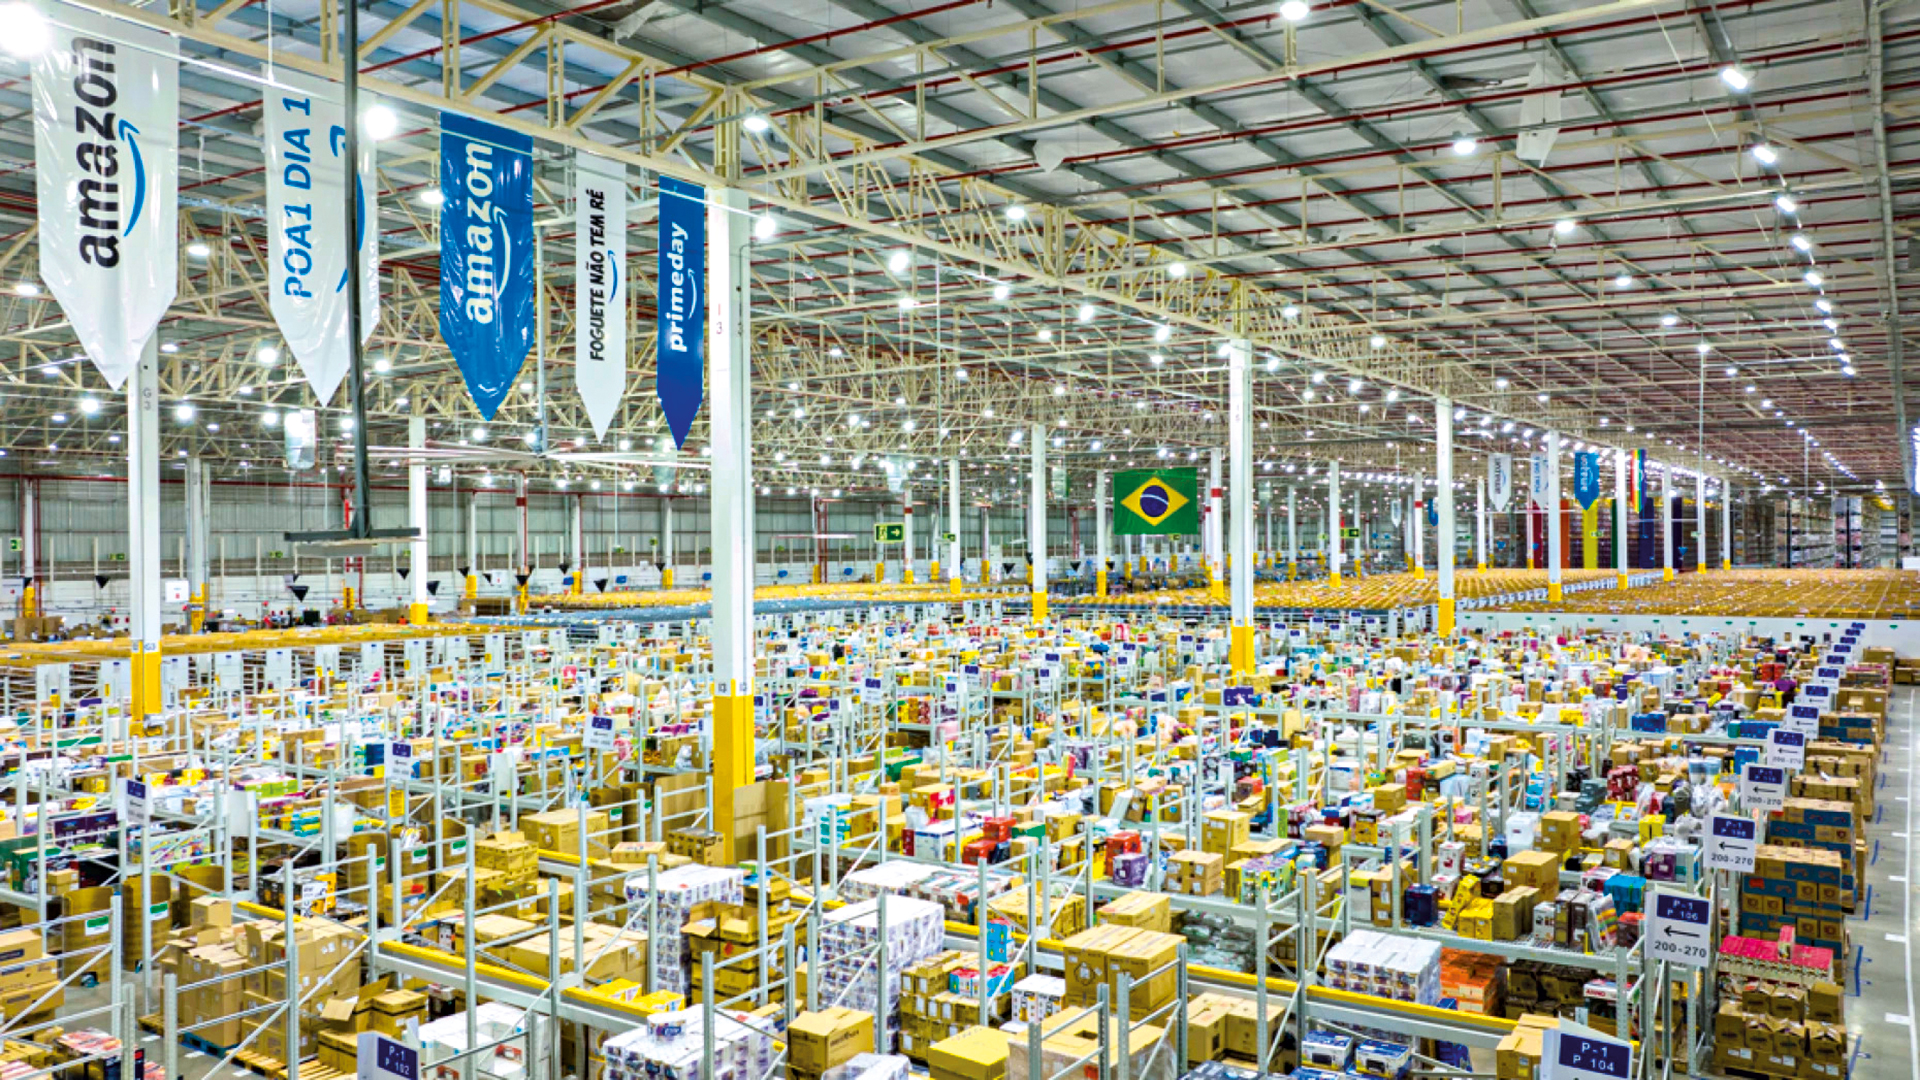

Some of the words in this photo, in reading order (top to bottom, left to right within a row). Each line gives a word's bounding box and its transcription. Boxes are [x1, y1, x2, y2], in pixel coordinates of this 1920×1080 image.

[282, 97, 310, 117] 1
[72, 37, 120, 268] amazon
[283, 128, 311, 191] DIA
[585, 188, 605, 211] RÉ
[465, 142, 494, 325] amazon
[590, 214, 605, 249] TEM
[284, 203, 313, 298] POA1
[585, 250, 605, 287] NÃO
[662, 222, 689, 353] primeday
[590, 289, 605, 361] FOGUETE
[1711, 853, 1754, 866] 200-270
[1667, 908, 1674, 916] P
[1679, 910, 1699, 921] 106
[1672, 899, 1694, 911] P-1
[1653, 940, 1708, 959] 200-270
[389, 1045, 405, 1061] P-1
[1581, 1042, 1609, 1058] P-1
[394, 1061, 409, 1076] 102
[1572, 1054, 1582, 1064] P
[1590, 1058, 1615, 1072] 104
